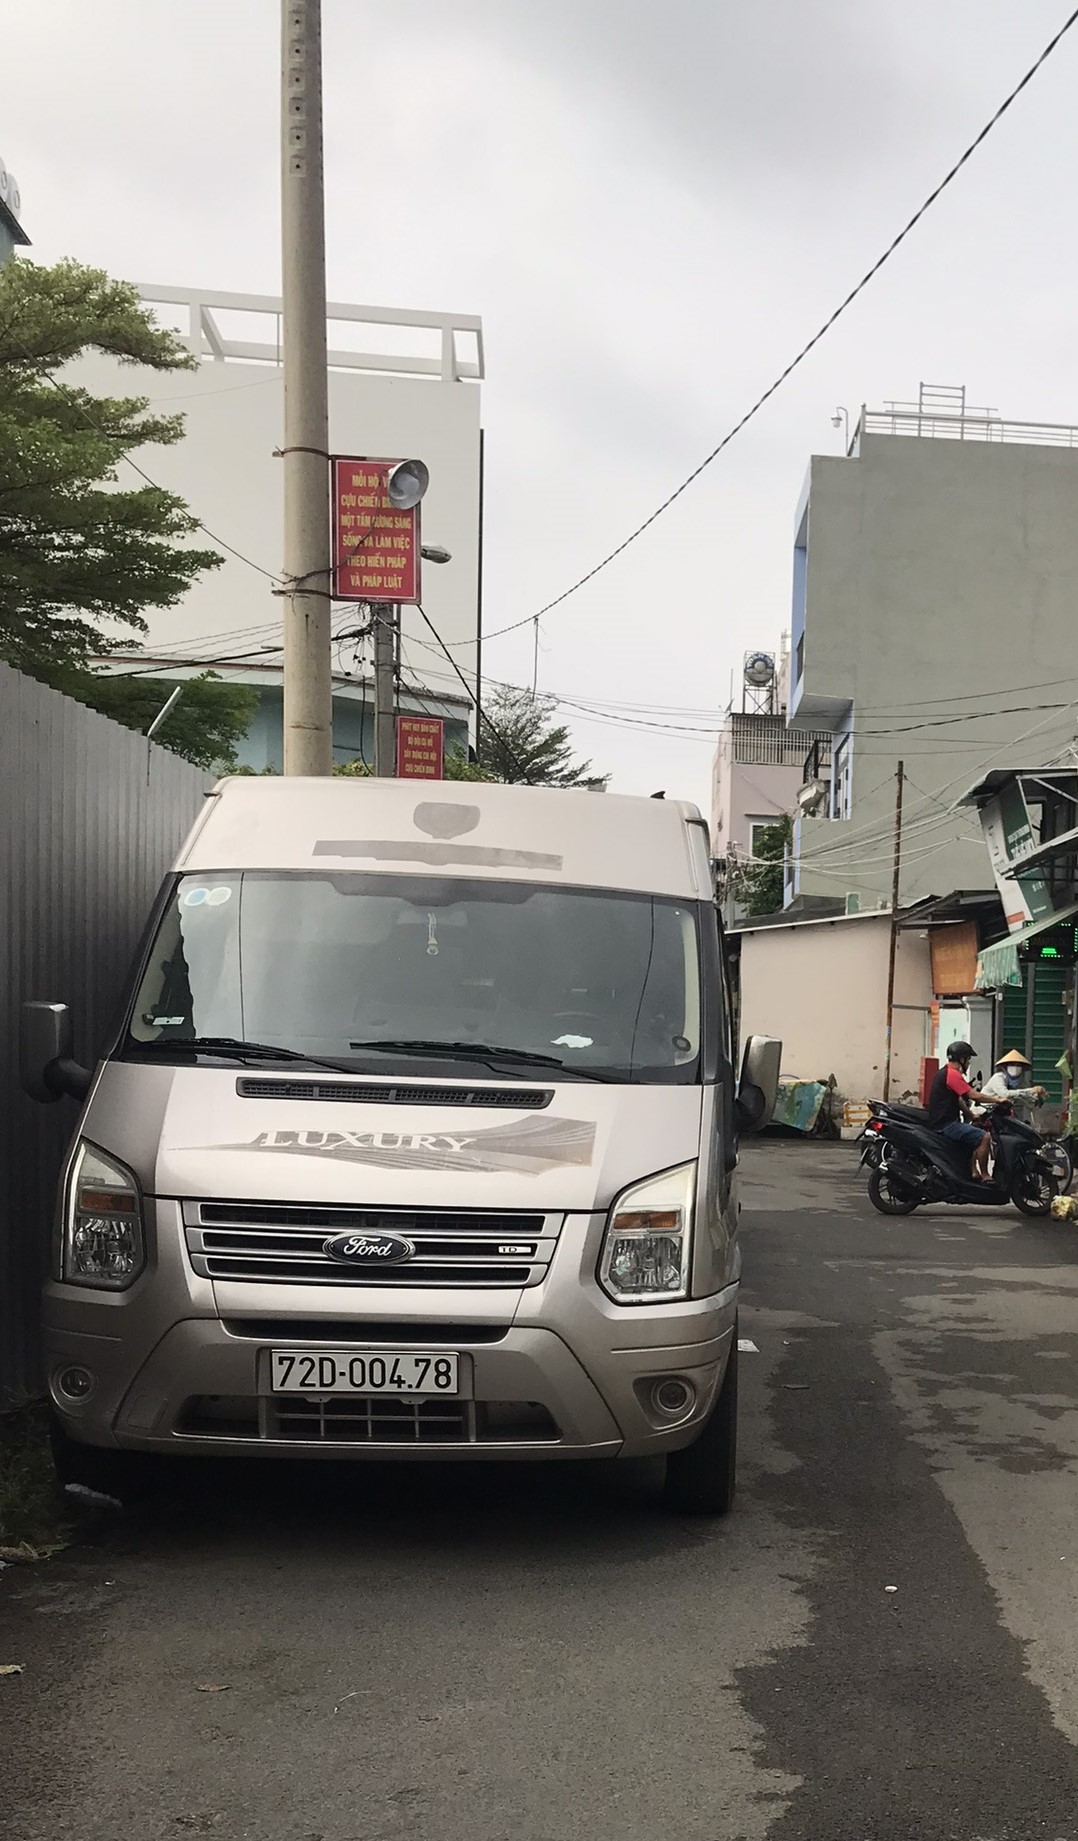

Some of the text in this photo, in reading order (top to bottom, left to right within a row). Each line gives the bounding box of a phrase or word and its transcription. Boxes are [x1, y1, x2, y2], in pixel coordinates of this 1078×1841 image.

[367, 473, 380, 489] HỘ
[341, 493, 356, 508] CỰU
[341, 512, 355, 528] MỘT
[357, 511, 371, 527] TẤM
[394, 514, 412, 529] SÁNG
[375, 535, 392, 548] LÀM
[392, 534, 410, 551] VIỆC
[367, 551, 385, 568] HIẾN
[387, 555, 406, 569] PHÁP
[350, 572, 403, 590] VÀ PHÁP LUẬT
[260, 1130, 478, 1152] LUXURY
[343, 1236, 393, 1257] Ford
[278, 1356, 451, 1389] 72D-004.78
